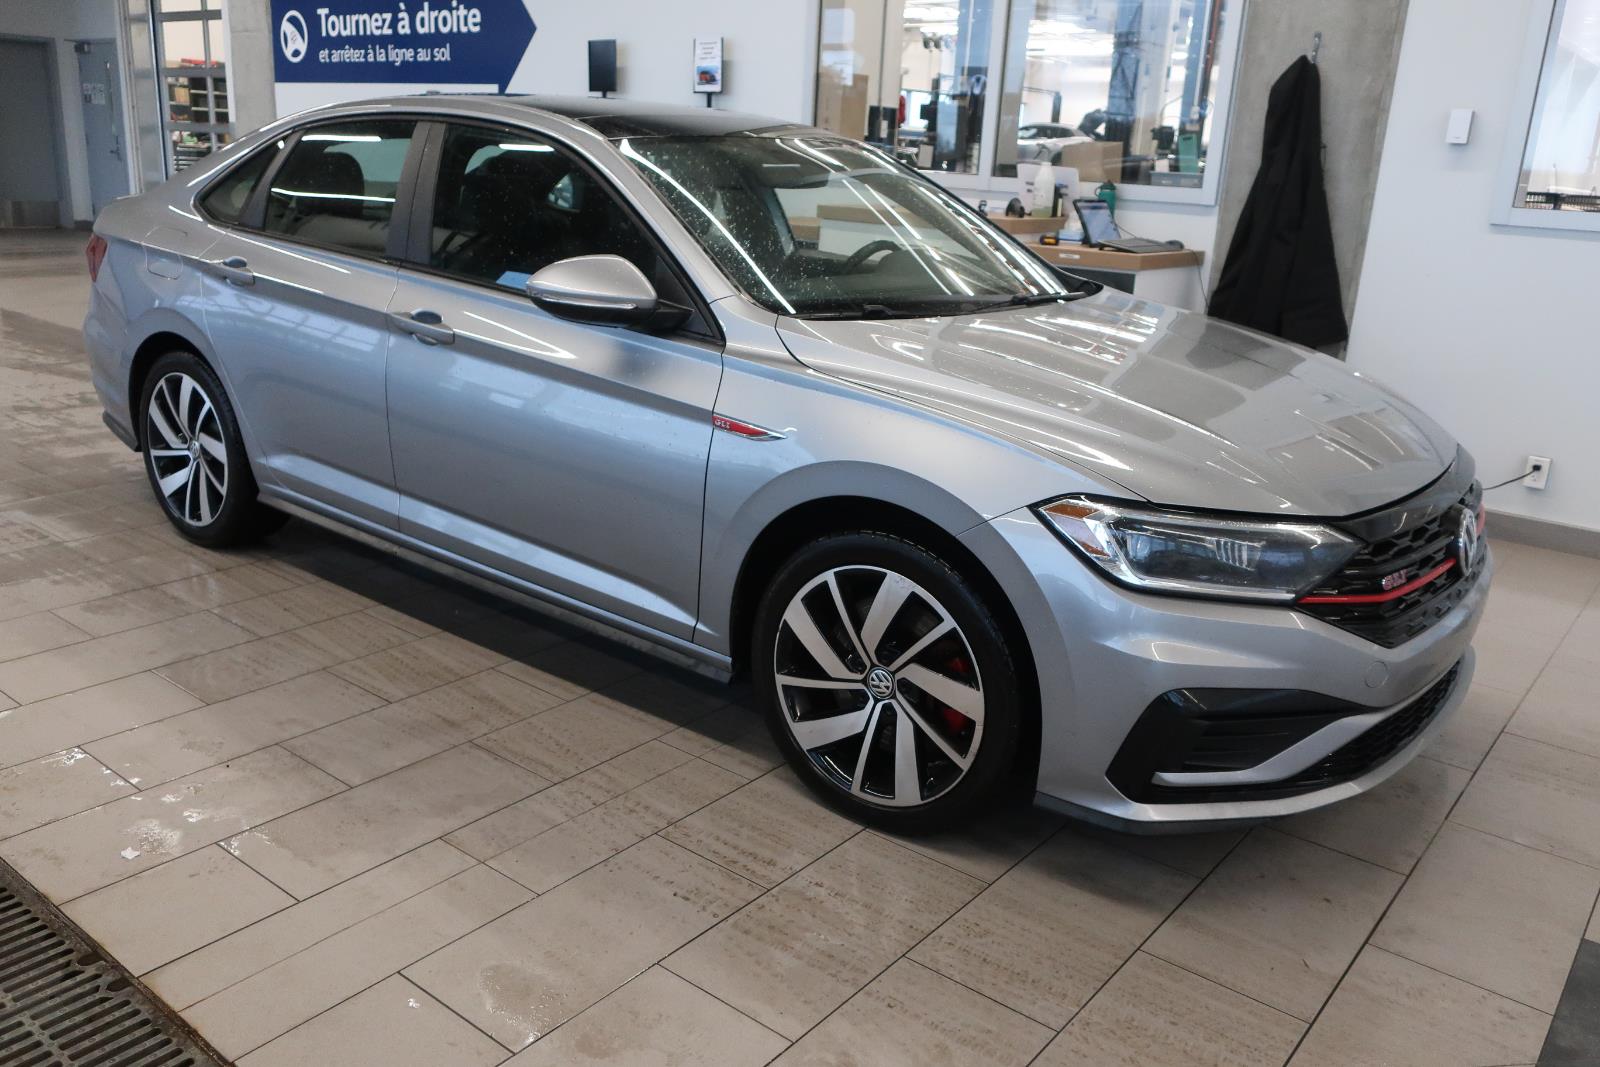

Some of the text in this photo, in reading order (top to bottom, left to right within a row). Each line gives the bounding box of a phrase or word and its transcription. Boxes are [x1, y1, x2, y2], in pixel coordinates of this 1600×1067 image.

[317, 0, 482, 37] Tournez à droite
[319, 43, 451, 66] et arrêtez à la ligne au sol
